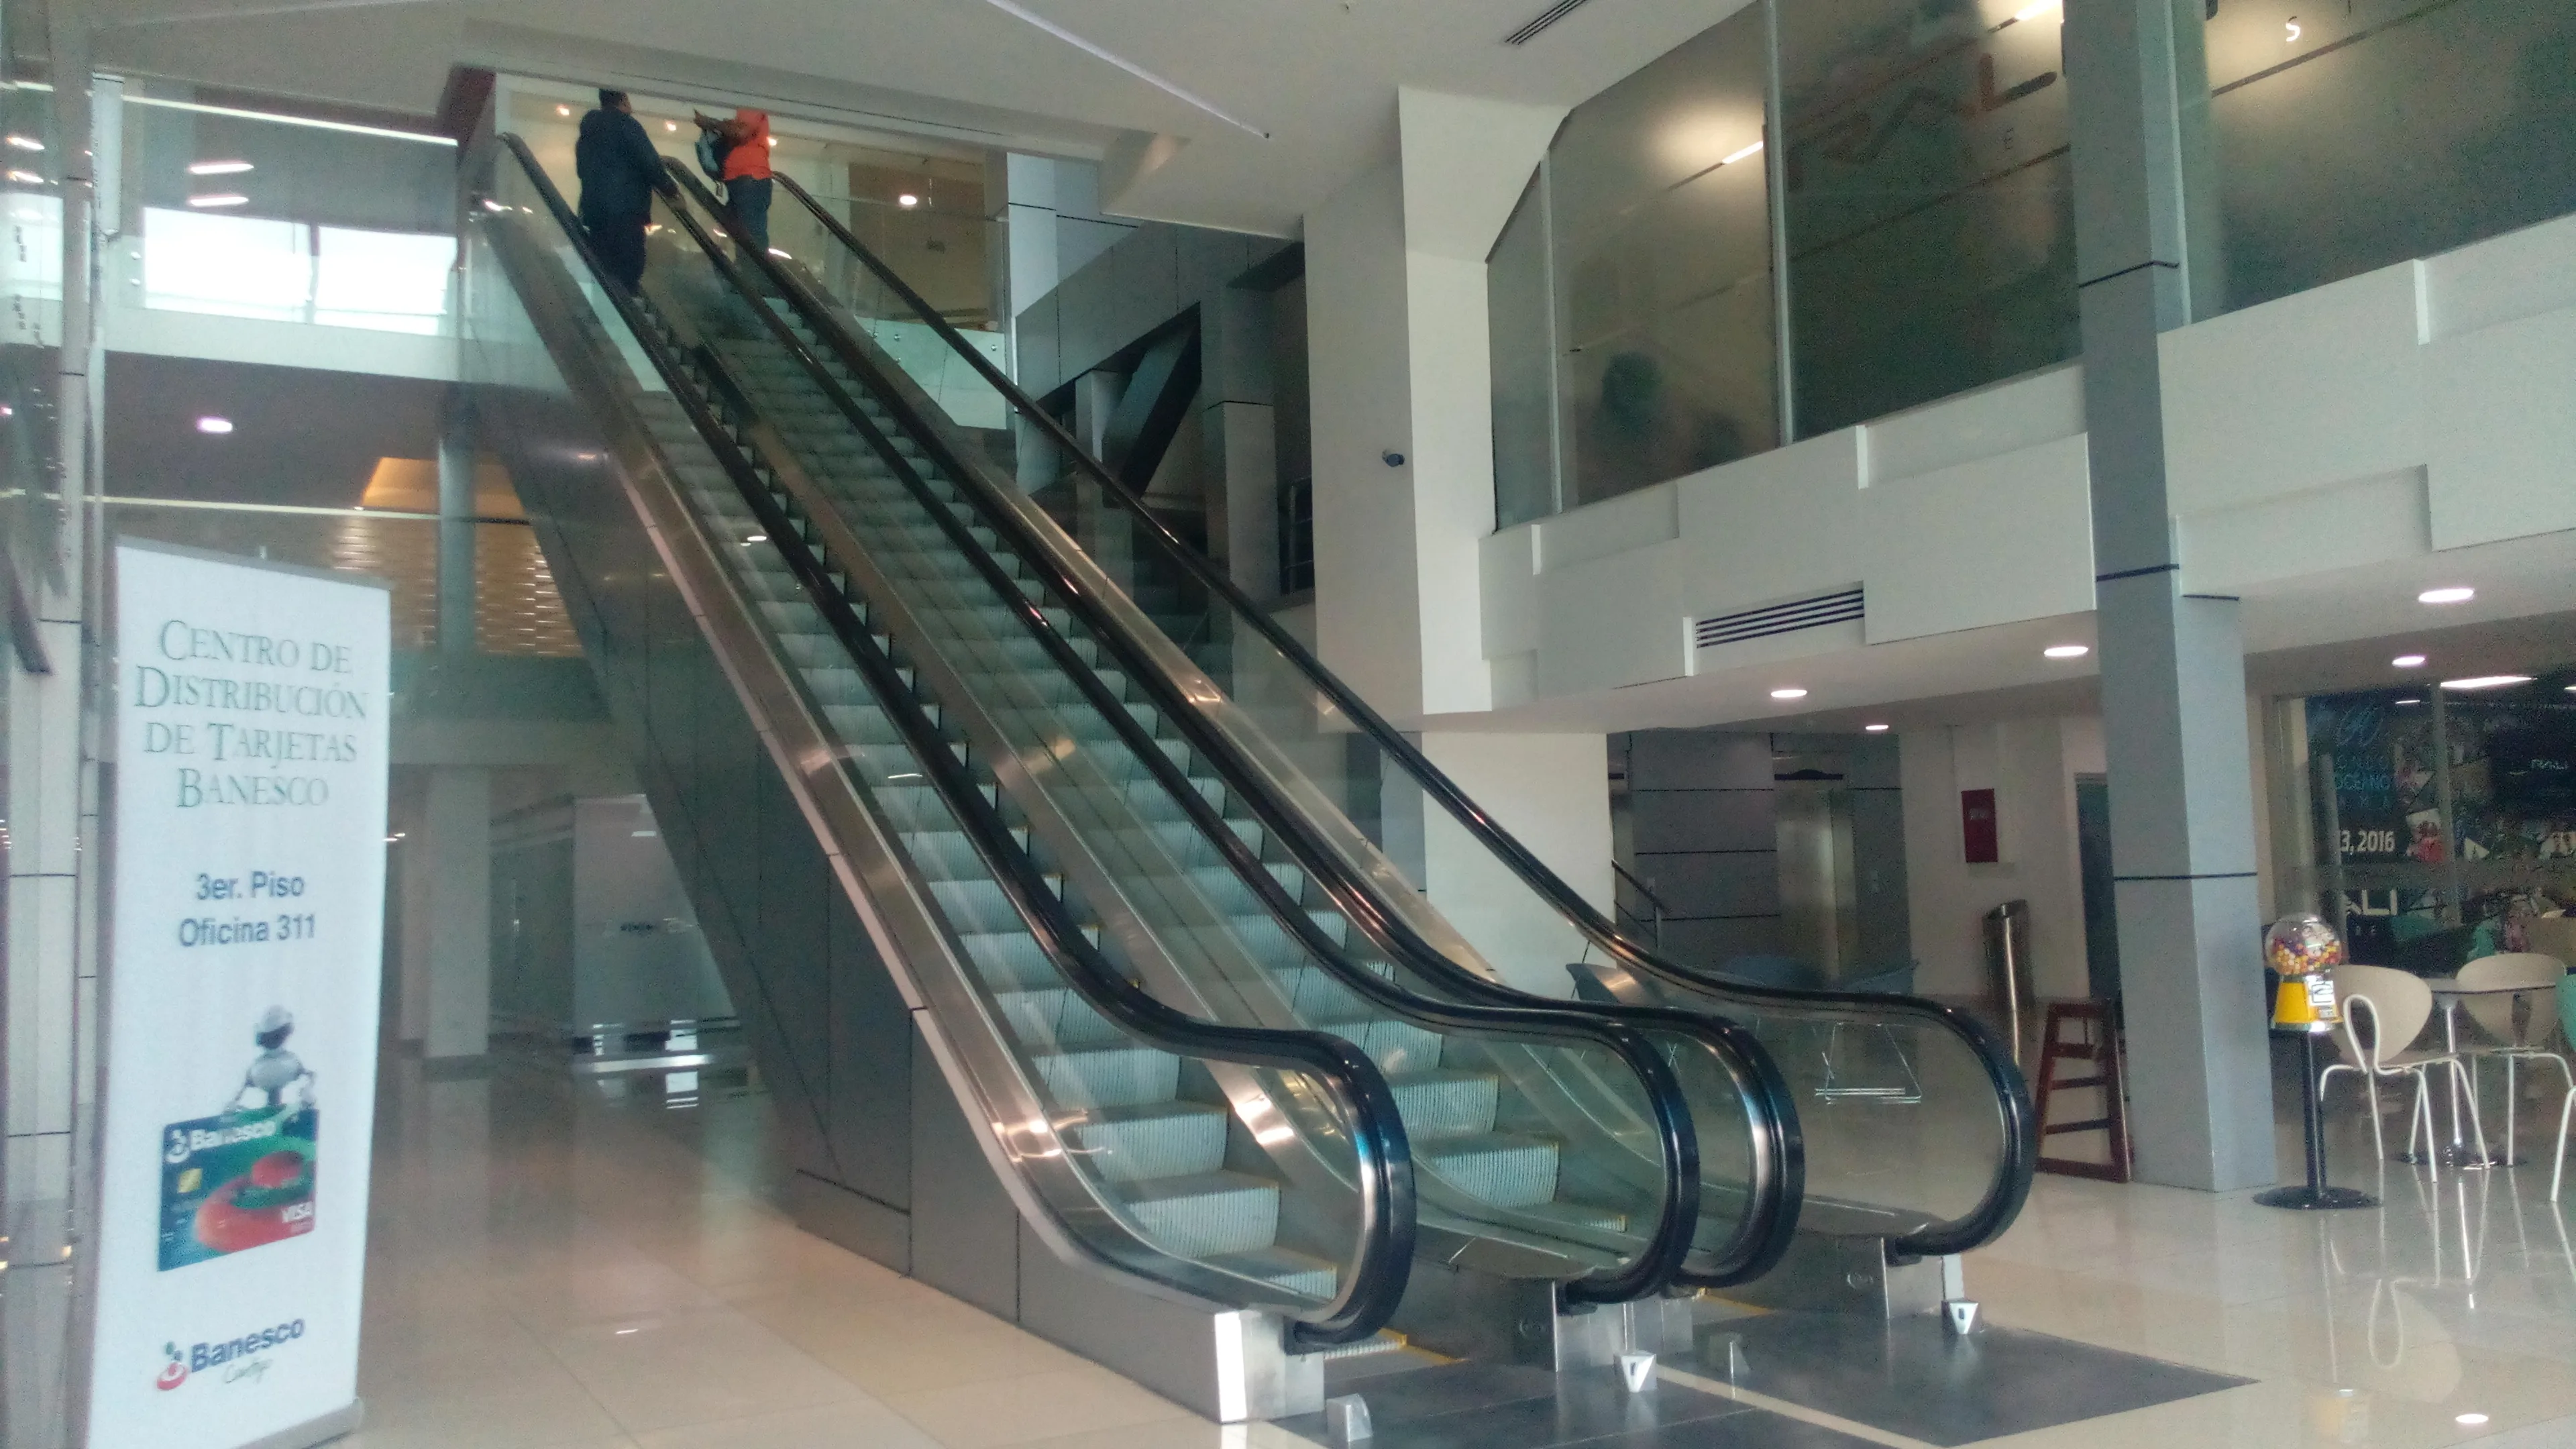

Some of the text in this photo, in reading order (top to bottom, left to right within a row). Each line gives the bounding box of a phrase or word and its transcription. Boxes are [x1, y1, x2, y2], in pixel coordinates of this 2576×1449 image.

[158, 619, 353, 674] CENTRO DE
[134, 664, 370, 719] DISTRIBUCIÓN
[144, 721, 358, 769] DE TARJETAS
[176, 767, 330, 808] BANESCO
[2357, 830, 2396, 852] 2016
[197, 870, 306, 902] 3er. Piso
[178, 914, 316, 947] Oficina 311
[191, 1318, 305, 1373] Banesco
